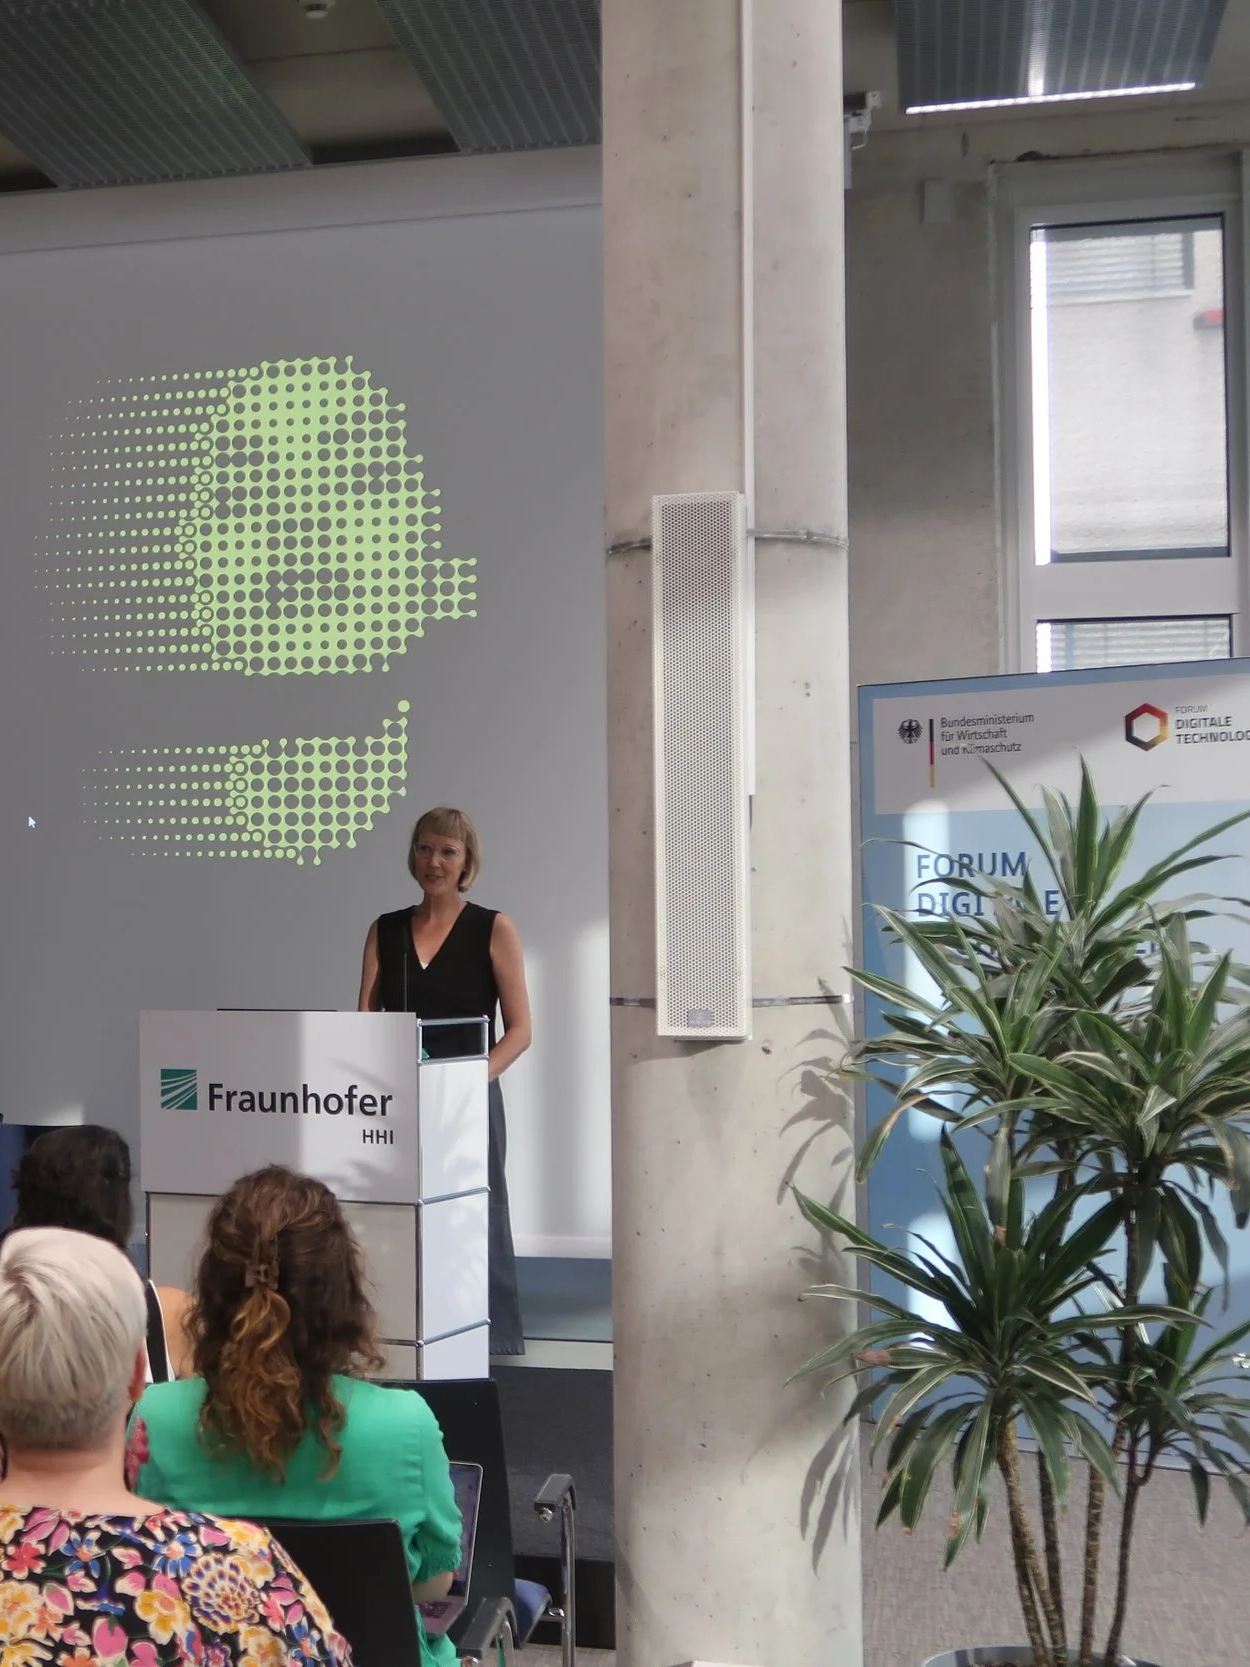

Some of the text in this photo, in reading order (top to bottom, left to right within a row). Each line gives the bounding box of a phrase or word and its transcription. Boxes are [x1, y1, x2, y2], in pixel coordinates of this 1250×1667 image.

[1175, 705, 1208, 714] FORUM
[941, 713, 1035, 728] Bundesministerium
[1176, 716, 1232, 730] DIGITALE
[941, 727, 1008, 741] für Wirtschaft
[941, 745, 959, 756] und
[917, 852, 1027, 879] FORUM
[918, 890, 1060, 917] DIGIE
[208, 1083, 393, 1116] Fraunhofer
[362, 1129, 395, 1145] HHI
